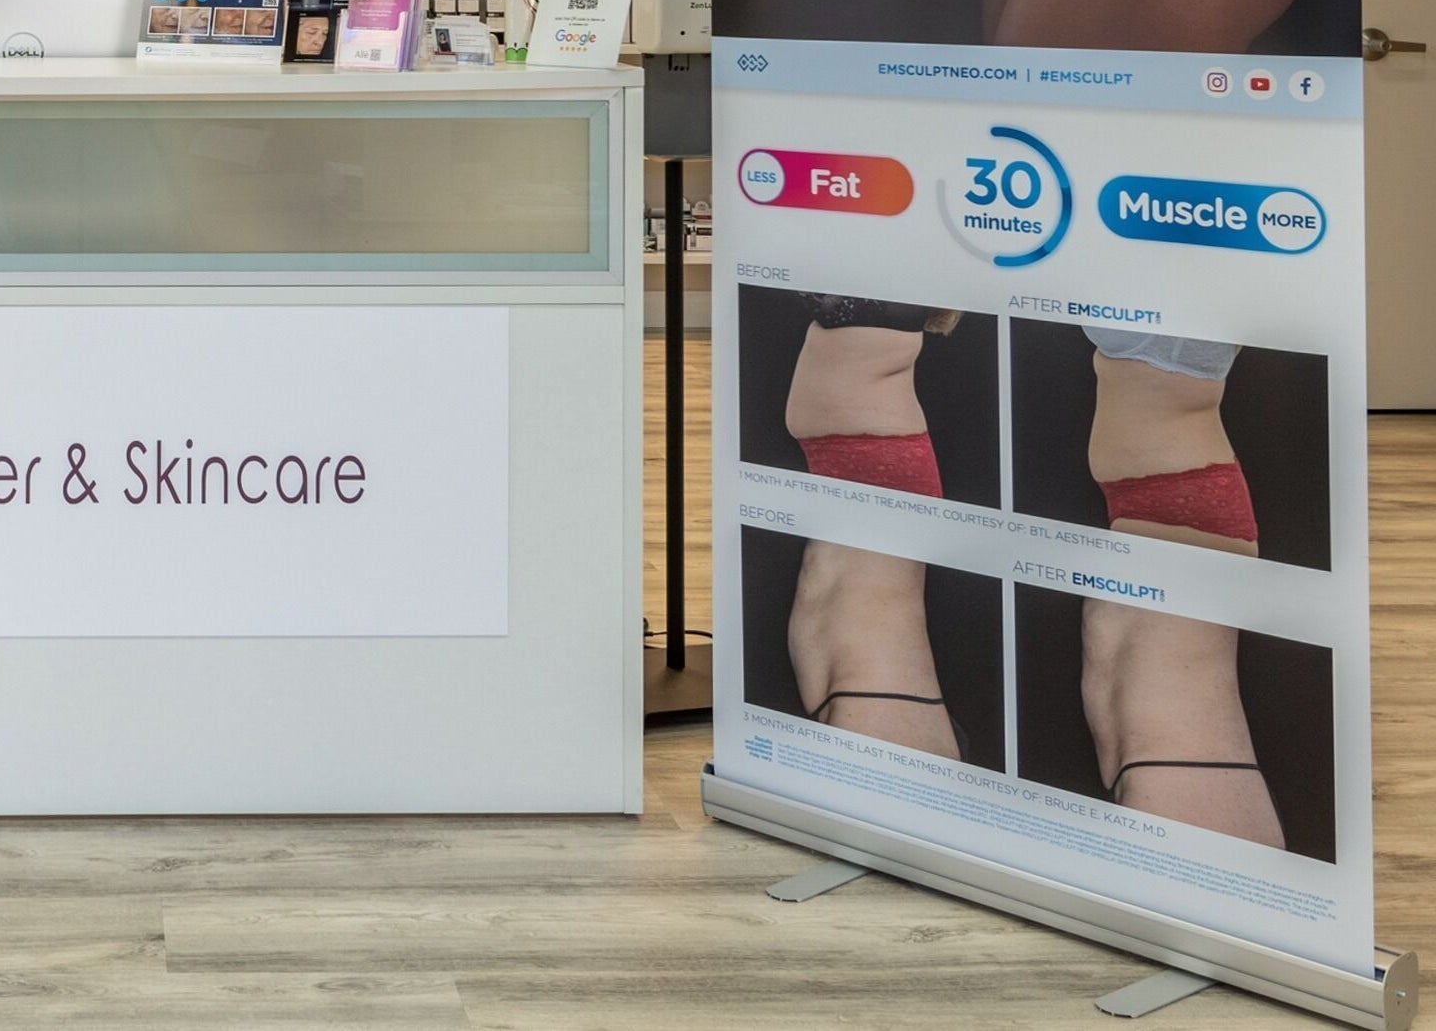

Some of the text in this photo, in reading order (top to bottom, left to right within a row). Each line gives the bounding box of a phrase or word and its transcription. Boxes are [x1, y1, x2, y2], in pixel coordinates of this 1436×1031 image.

[555, 29, 596, 46] Google
[878, 63, 1133, 85] EMSCULPTNEO.COM #EMSCULPT
[747, 168, 861, 199] LESS Fat
[965, 158, 1041, 208] 30
[964, 212, 1042, 234] minutes
[1119, 190, 1316, 230] Muscle MORE
[737, 263, 790, 281] BEFORE
[1008, 295, 1062, 313] AFTER
[1068, 302, 1156, 324] EMSCULPT
[63, 442, 99, 506] &
[123, 438, 366, 506] Skincare
[739, 504, 796, 526] BEFORE
[745, 473, 782, 487] MONTH
[784, 479, 818, 493] AFTER
[821, 485, 841, 497] THE
[844, 490, 870, 503] LAST
[943, 509, 1004, 529] COURTESY
[1030, 526, 1052, 539] BTL
[1055, 532, 1131, 554] AESTHETICS
[1012, 560, 1066, 583] AFTER
[1072, 572, 1159, 601] EMSCULPT
[743, 711, 749, 721] 3
[751, 714, 795, 734] MONTHS
[797, 726, 831, 744] AFTER
[834, 736, 854, 751] THE
[857, 743, 884, 759] LAST
[957, 771, 1020, 796] COURTESY
[1044, 795, 1087, 816] BRUCE
[1143, 823, 1169, 839] M.D.
